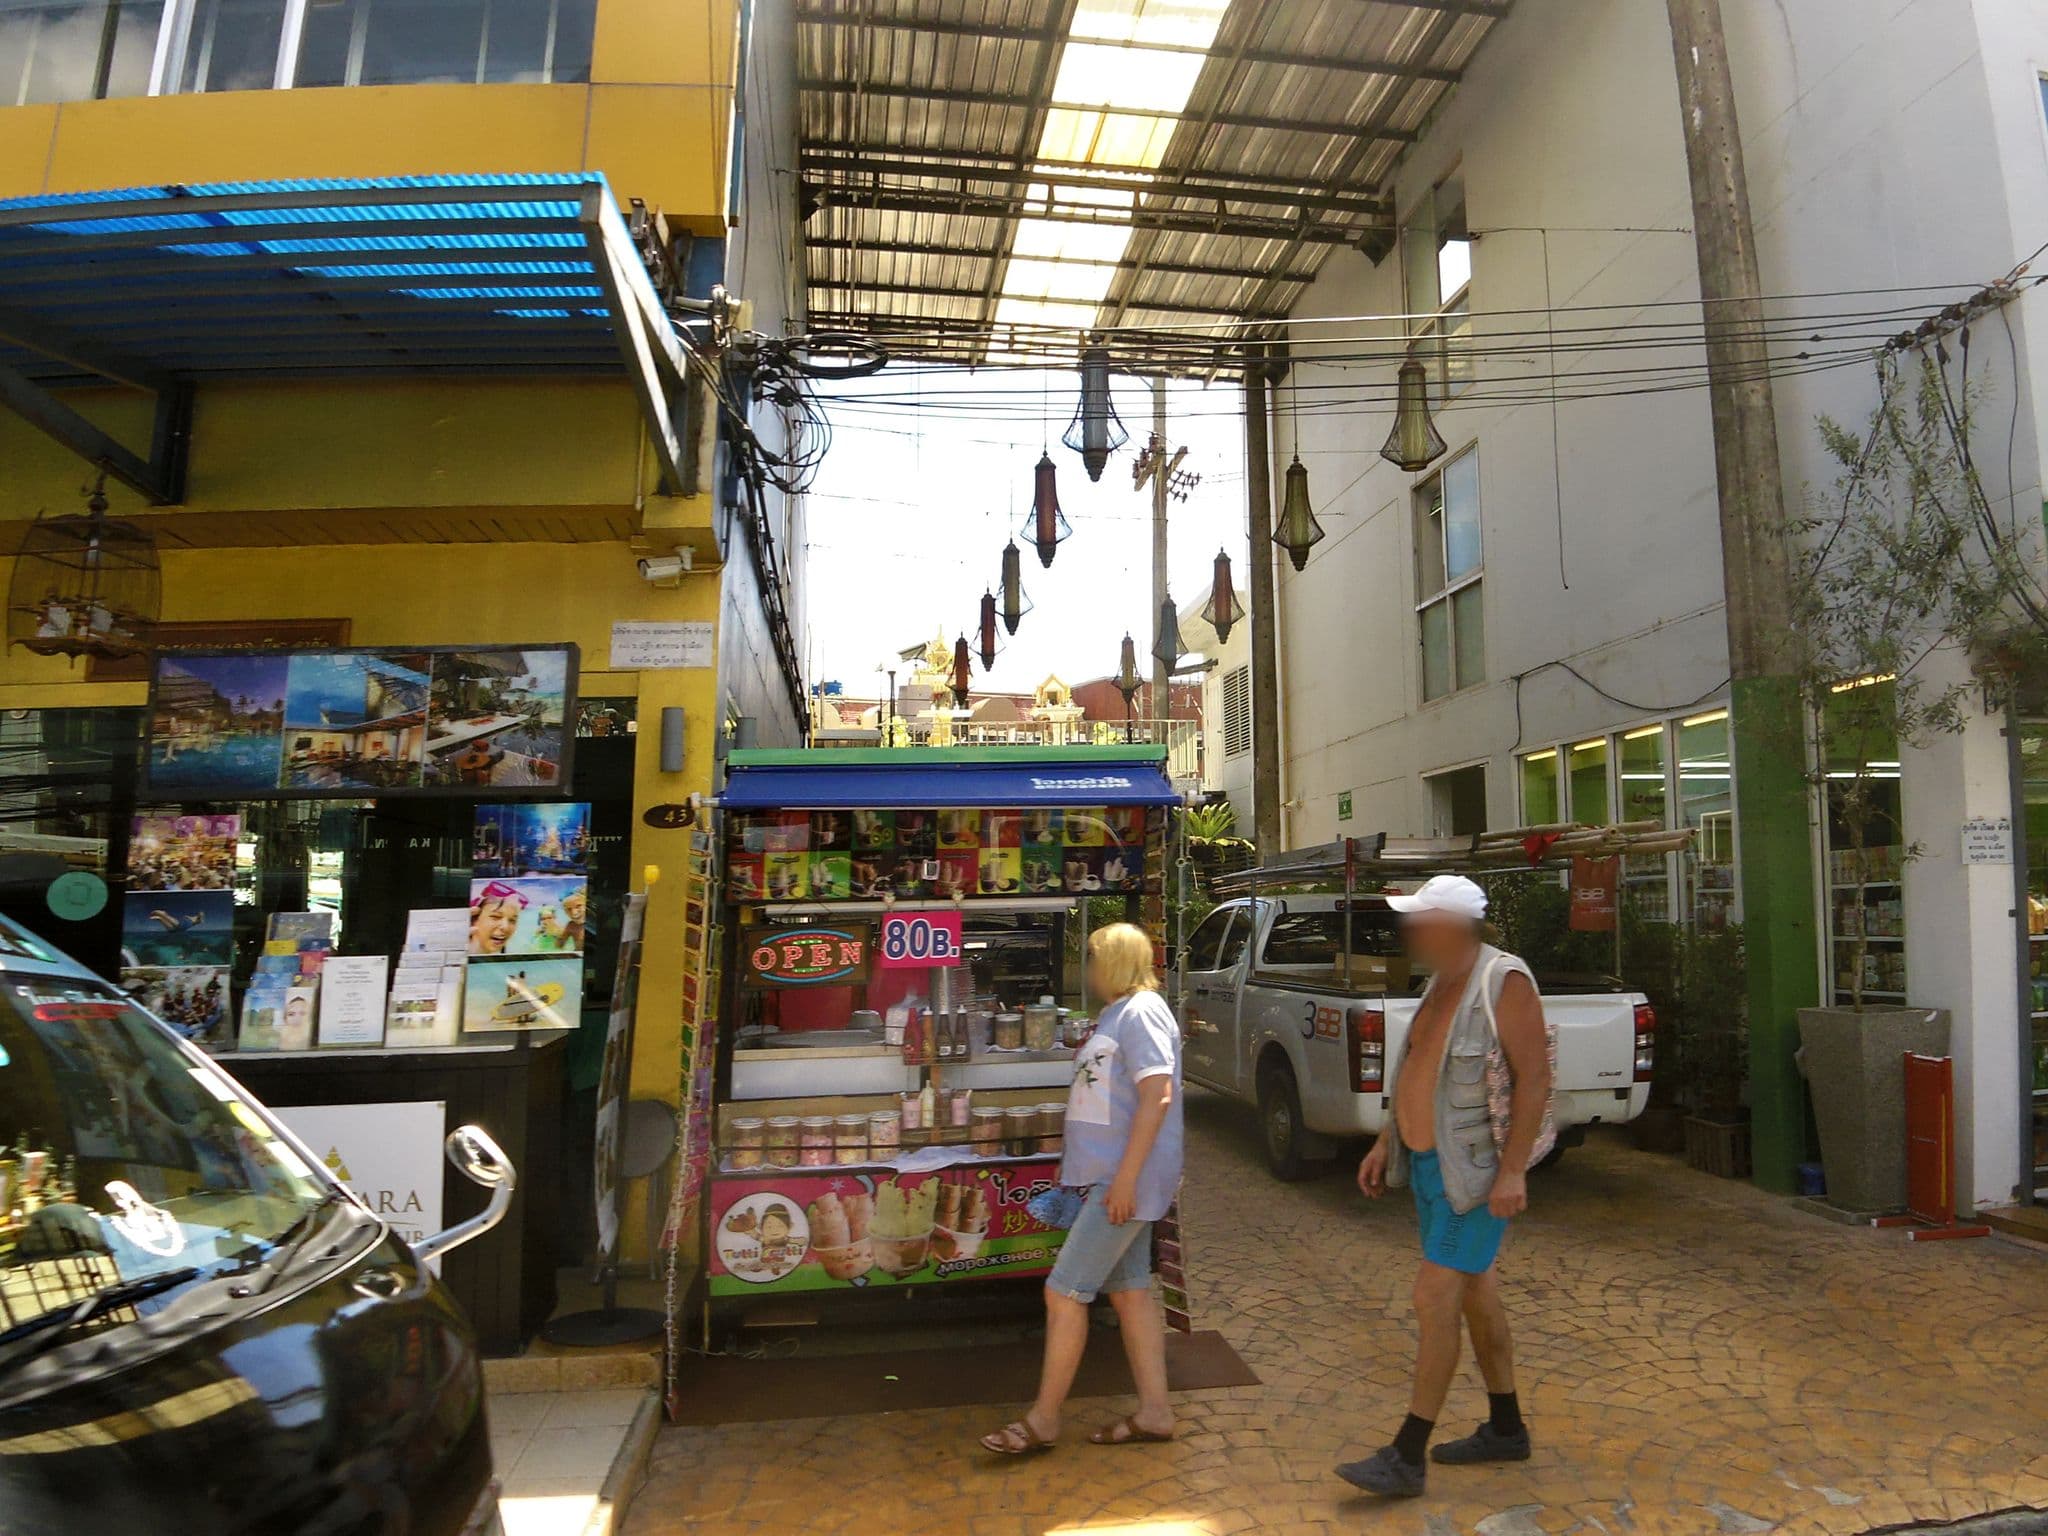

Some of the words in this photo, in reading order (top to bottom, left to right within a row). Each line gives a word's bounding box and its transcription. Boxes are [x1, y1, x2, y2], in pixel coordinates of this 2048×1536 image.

[664, 809, 687, 823] 43
[752, 941, 862, 970] OPEN
[1301, 1000, 1342, 1039] 3BB
[353, 1189, 424, 1213] ARA
[723, 1247, 759, 1259] Tutti
